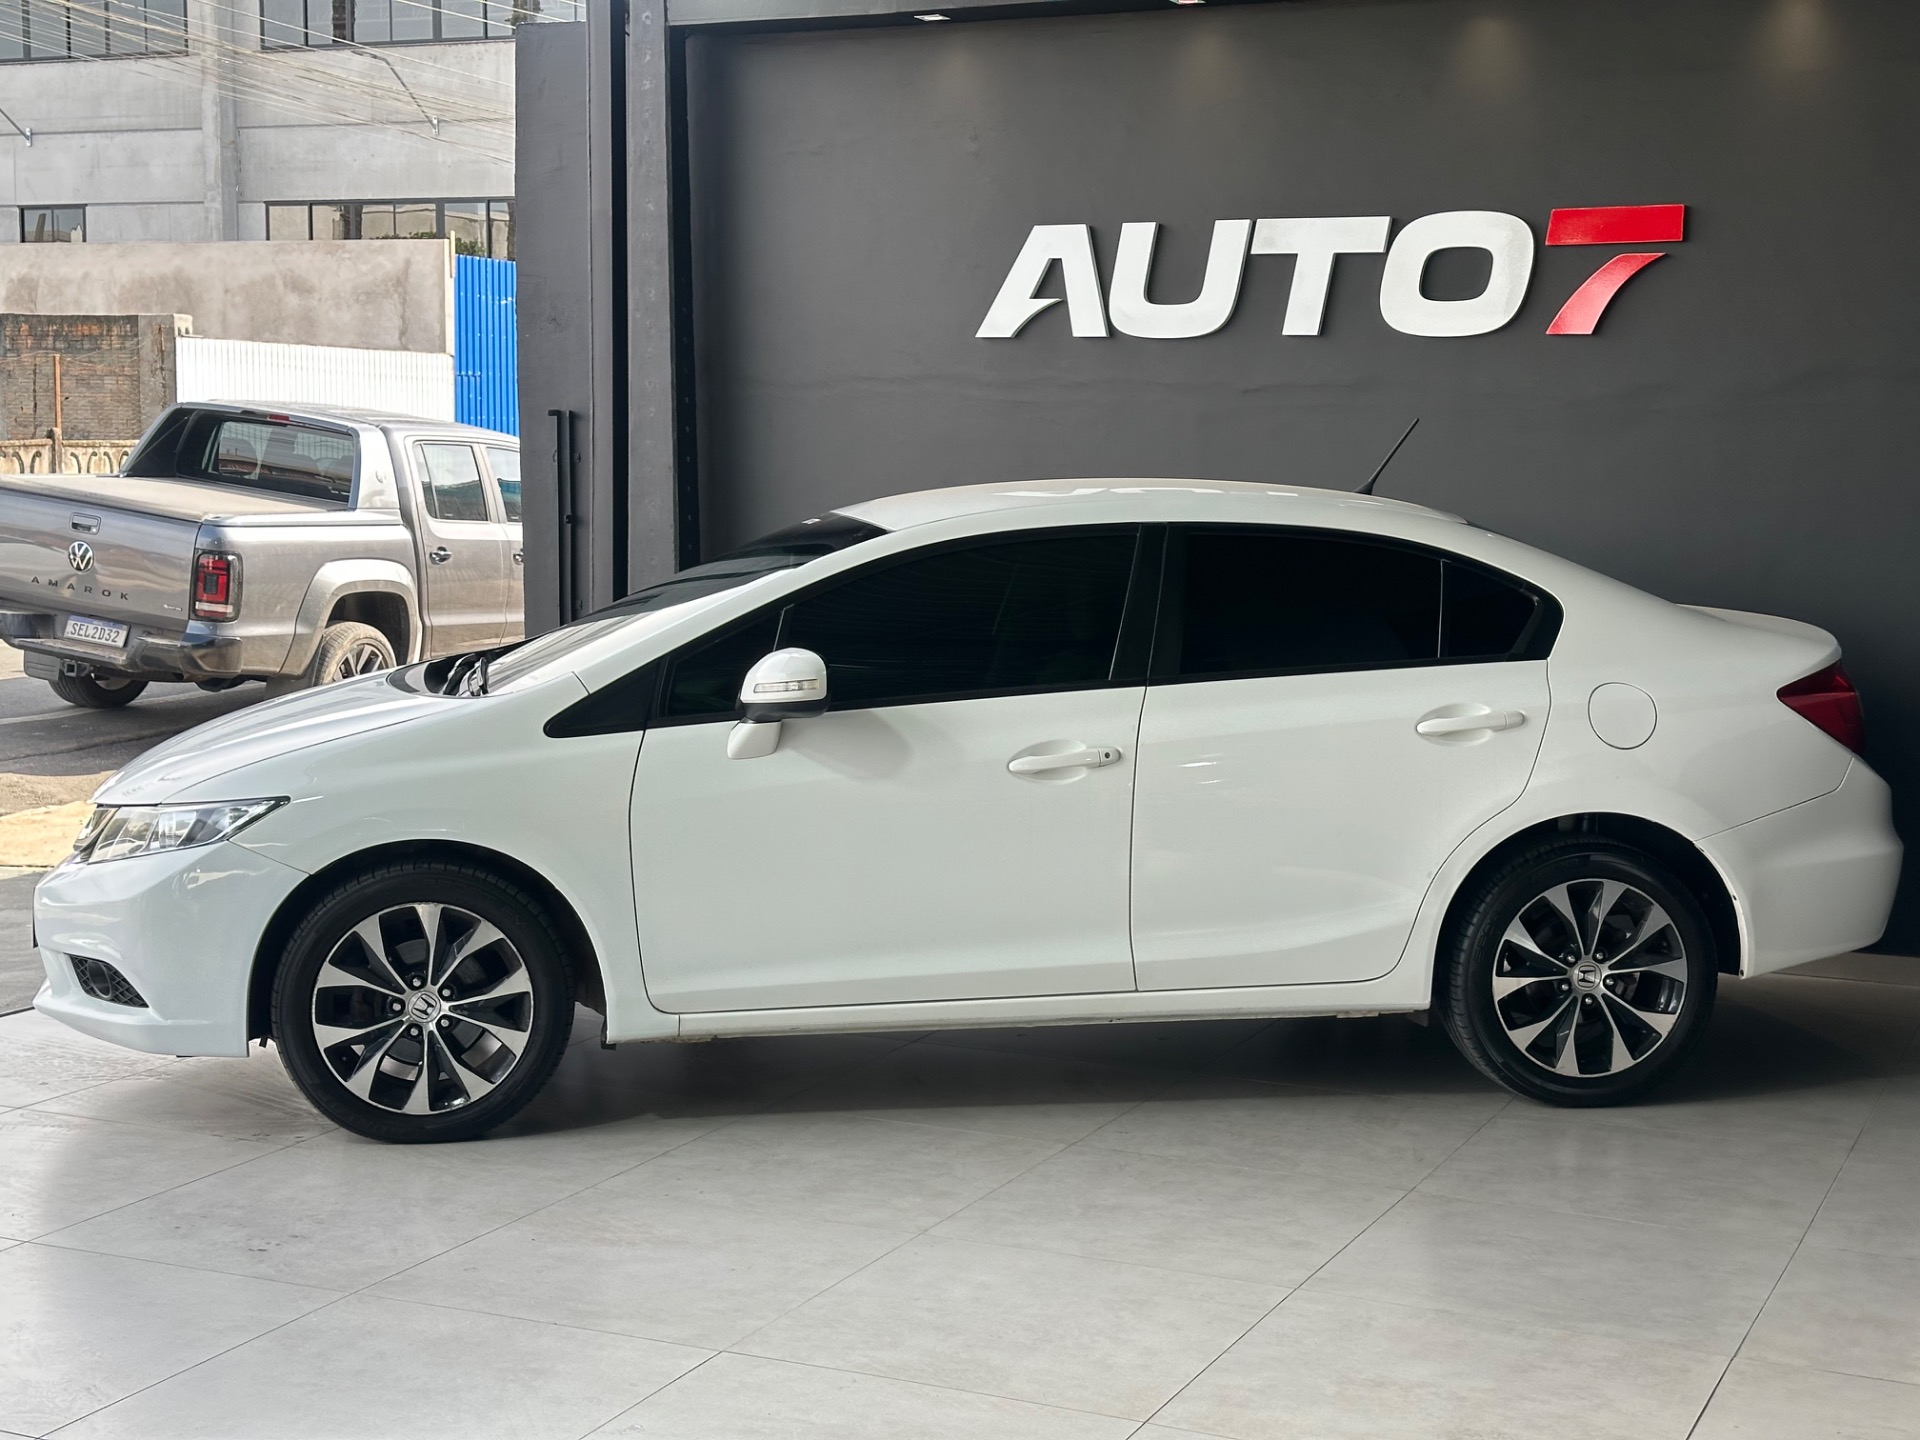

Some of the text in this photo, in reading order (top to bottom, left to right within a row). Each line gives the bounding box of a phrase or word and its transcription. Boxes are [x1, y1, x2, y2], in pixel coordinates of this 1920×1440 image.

[975, 203, 1686, 339] AUTO7
[30, 575, 129, 601] AMAROK
[70, 622, 120, 643] SEL2D32
